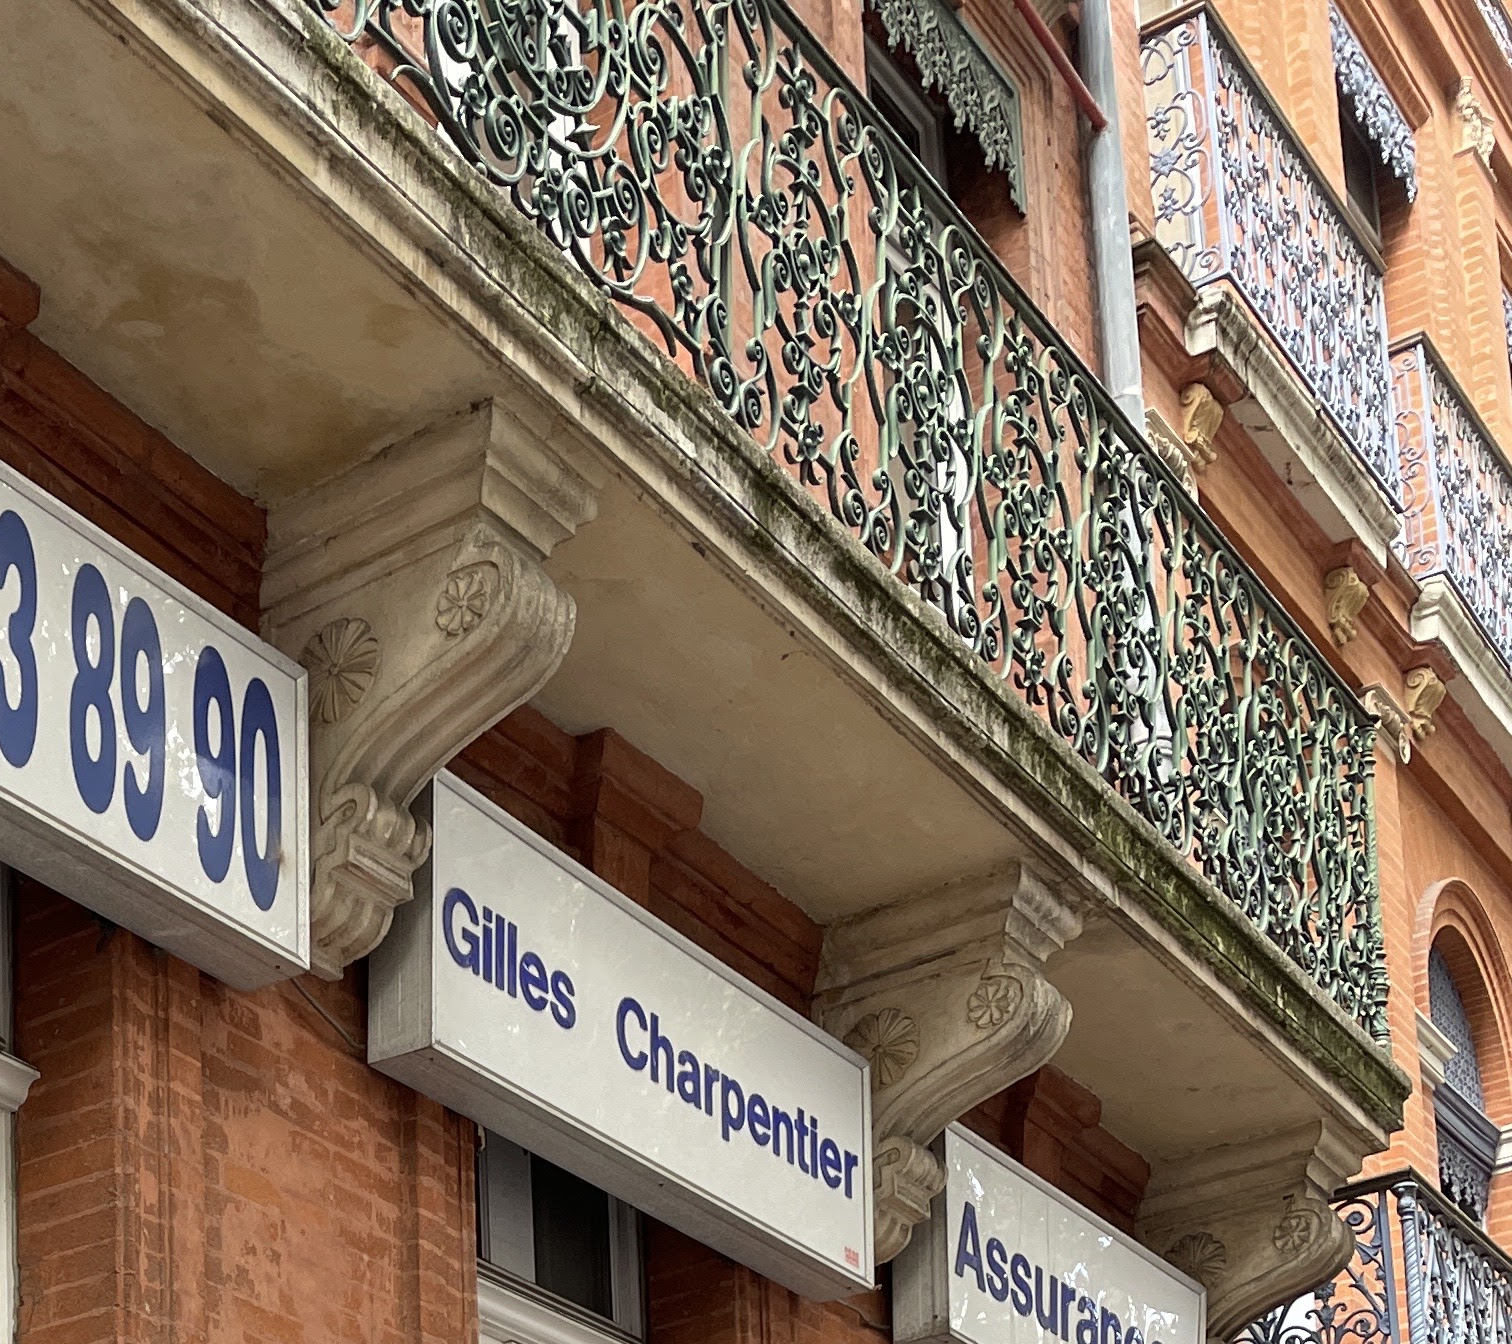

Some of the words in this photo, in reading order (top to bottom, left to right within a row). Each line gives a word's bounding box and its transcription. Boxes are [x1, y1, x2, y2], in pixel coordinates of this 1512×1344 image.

[70, 564, 166, 842] 89
[192, 647, 282, 911] 90
[442, 887, 578, 1031] Gilles
[616, 997, 859, 1199] Charpentier
